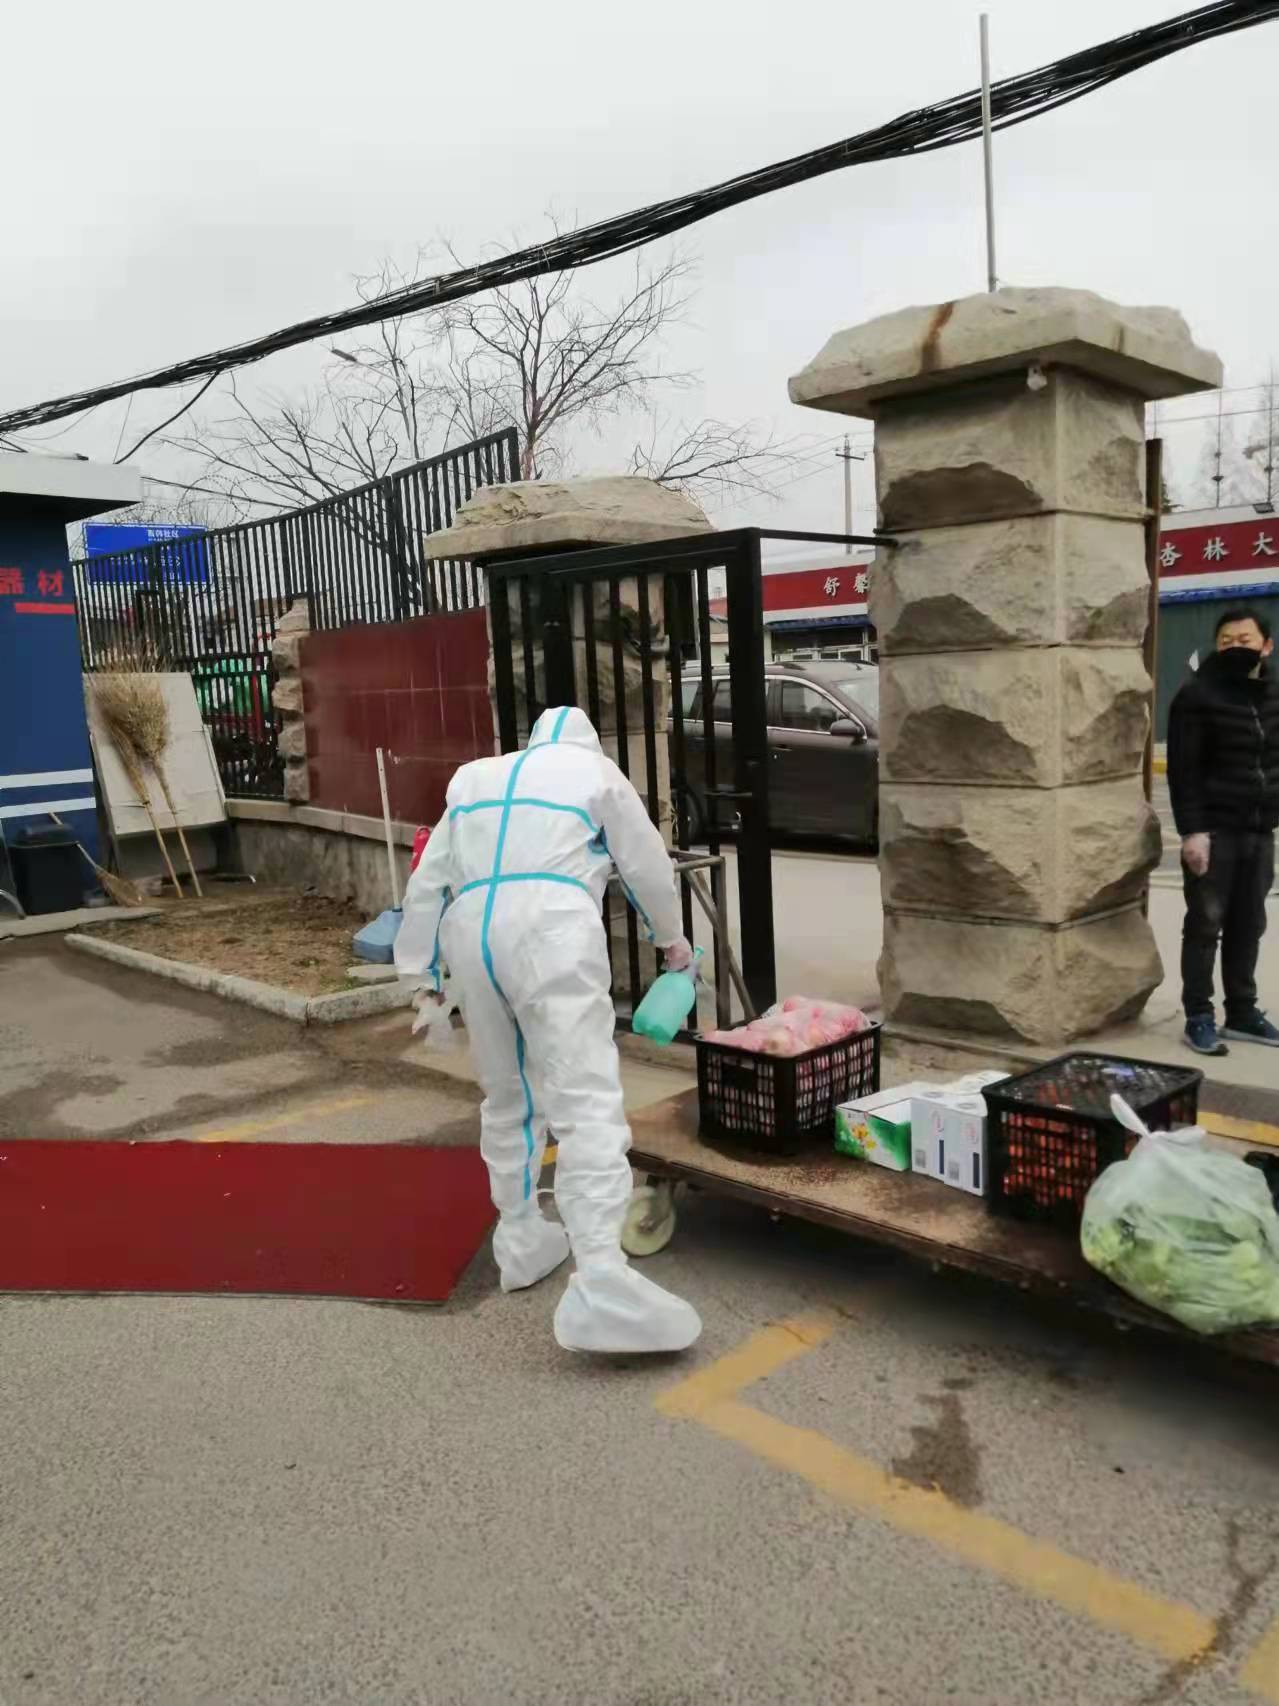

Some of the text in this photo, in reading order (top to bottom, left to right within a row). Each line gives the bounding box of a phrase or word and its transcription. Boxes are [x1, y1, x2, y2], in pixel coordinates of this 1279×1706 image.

[1159, 531, 1279, 567] 杏林大
[0, 567, 65, 597] 器材
